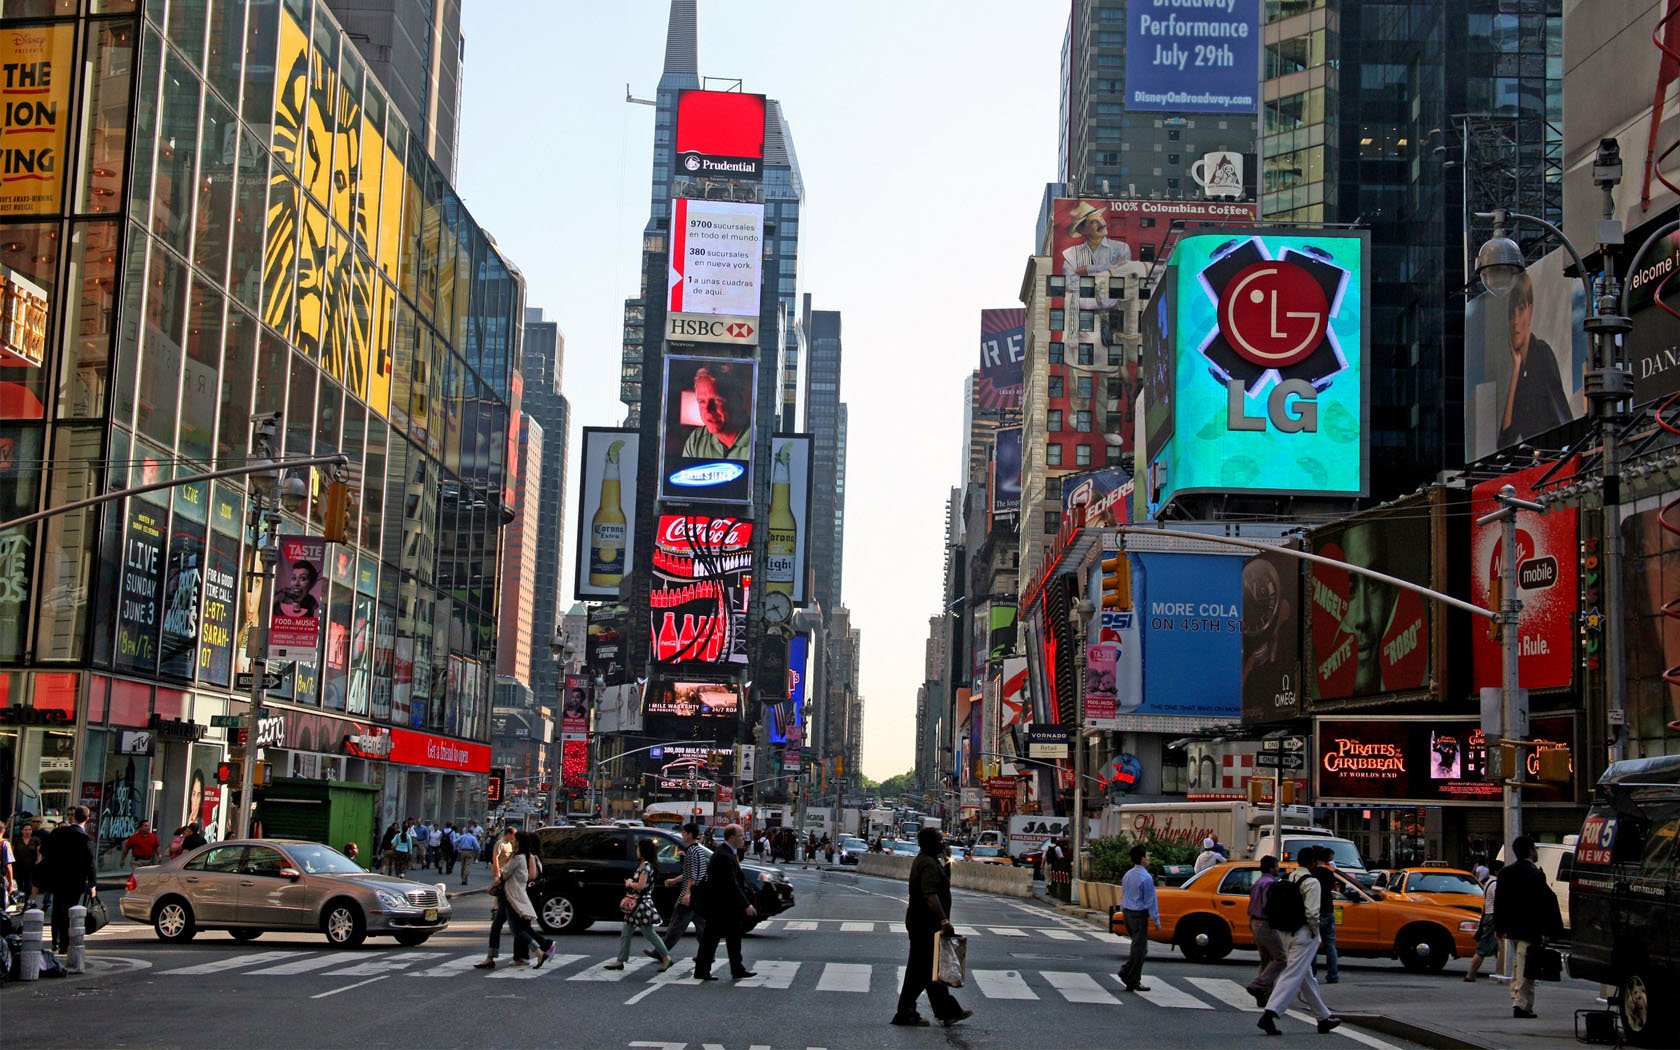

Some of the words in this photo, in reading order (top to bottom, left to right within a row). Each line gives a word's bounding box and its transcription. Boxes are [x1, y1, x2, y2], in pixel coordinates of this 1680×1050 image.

[1140, 14, 1249, 38] Performance
[1152, 43, 1188, 70] July
[1194, 43, 1234, 67] 29th
[3, 61, 51, 88] THE
[1134, 90, 1252, 106] DisneyOnBroadway.com
[0, 101, 57, 130] ION
[0, 147, 55, 174] ING
[703, 159, 755, 173] Prudential
[1110, 201, 1139, 212] 100%
[1141, 202, 1206, 214] Colombian
[1208, 204, 1249, 216] Coffee
[690, 220, 713, 229] 9700
[713, 222, 755, 232] sucursales
[689, 231, 699, 239] en
[701, 231, 720, 240] todo
[721, 232, 729, 240] el
[689, 247, 706, 256] 380
[706, 249, 749, 259] sucursales
[694, 259, 705, 267] en
[706, 260, 731, 268] nueva
[732, 261, 753, 270] york.
[688, 275, 693, 283] 1
[701, 278, 720, 286] unas
[721, 278, 754, 288] cuadras
[692, 287, 703, 295] de
[670, 319, 724, 337] HSBC
[1226, 377, 1319, 434] LG
[182, 484, 199, 505] LIVE
[1086, 477, 1135, 521] ECHERS
[996, 500, 1006, 508] The
[594, 523, 624, 535] Corona
[665, 517, 742, 545] Coca-Cola
[127, 538, 159, 575] LIVE
[288, 543, 323, 557] TASTE
[207, 567, 217, 583] FOR
[217, 571, 221, 585] A
[221, 573, 234, 589] GOOD
[1523, 562, 1553, 584] mobile
[126, 573, 157, 599] SUNDAY
[206, 582, 219, 599] TIME
[123, 599, 145, 624] JUNE
[147, 601, 155, 625] 3
[204, 600, 227, 622] 1-877-
[1152, 602, 1195, 616] MORE
[1199, 603, 1239, 617] COLA
[274, 617, 292, 625] FOOD
[295, 619, 316, 627] MUSIC
[1101, 613, 1134, 629] PSI
[1151, 617, 1174, 630] ON
[1180, 618, 1221, 633] 45TH
[203, 623, 230, 647] SARAH-
[1093, 649, 1115, 657] TASTE
[1523, 634, 1551, 657] Rule.
[201, 647, 212, 668] 07
[242, 677, 253, 685] ON
[570, 679, 588, 687] TASTE
[1274, 691, 1296, 707] OMEGA
[222, 716, 233, 725] 44
[663, 746, 685, 754] 100,000
[1287, 740, 1299, 748] WAY
[1334, 738, 1396, 757] PIRATES
[1262, 756, 1275, 764] ONE
[1284, 757, 1298, 765] WAY
[1323, 752, 1406, 772] CARIBBEAN
[807, 811, 825, 822] icana
[1132, 813, 1214, 850] Budweiser
[1581, 822, 1604, 844] FOX
[1601, 819, 1617, 848] 5
[1577, 850, 1612, 863] NEWS
